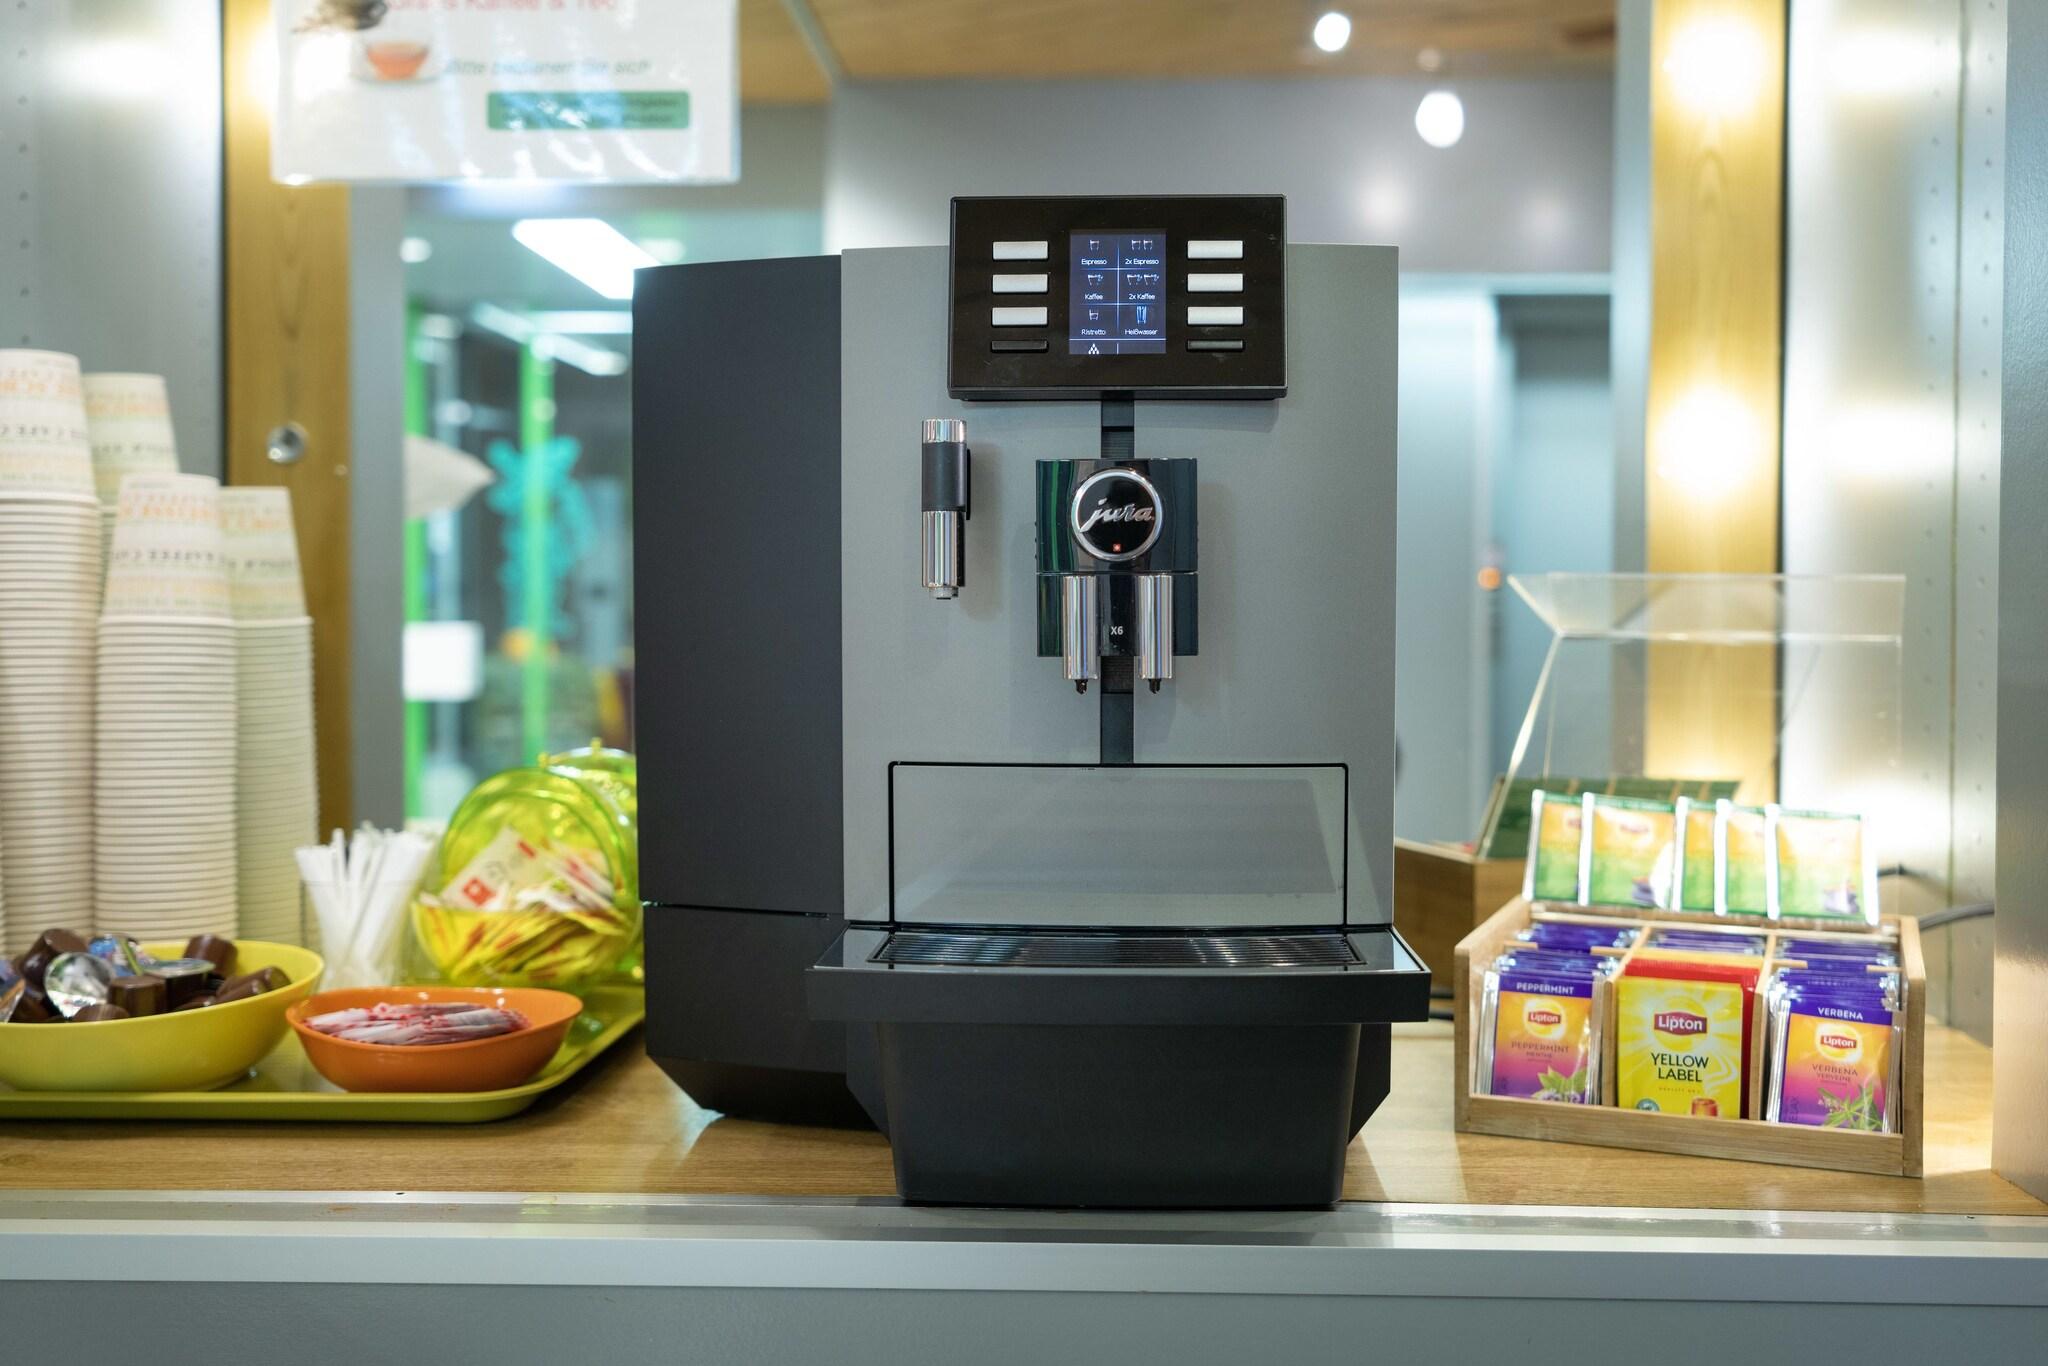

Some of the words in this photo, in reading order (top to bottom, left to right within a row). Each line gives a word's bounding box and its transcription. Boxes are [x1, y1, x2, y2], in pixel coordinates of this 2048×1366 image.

[1081, 258, 1107, 266] Espresso
[1133, 258, 1160, 266] Espresso
[1081, 328, 1106, 336] Ristretto
[1125, 328, 1158, 336] Heißwasser
[1079, 498, 1156, 533] jura
[1110, 626, 1124, 636] X6
[1516, 982, 1575, 995] PEPPERMINT
[1530, 1012, 1559, 1024] Lipton
[1817, 1007, 1864, 1021] VERBENA
[1658, 1015, 1703, 1032] Lipton
[1511, 1041, 1569, 1054] PEPPERMINT
[1823, 1035, 1854, 1048] Lipton
[1650, 1052, 1710, 1069] YELLOW
[1658, 1067, 1704, 1083] LABEL
[1812, 1063, 1859, 1076] VERBENA
